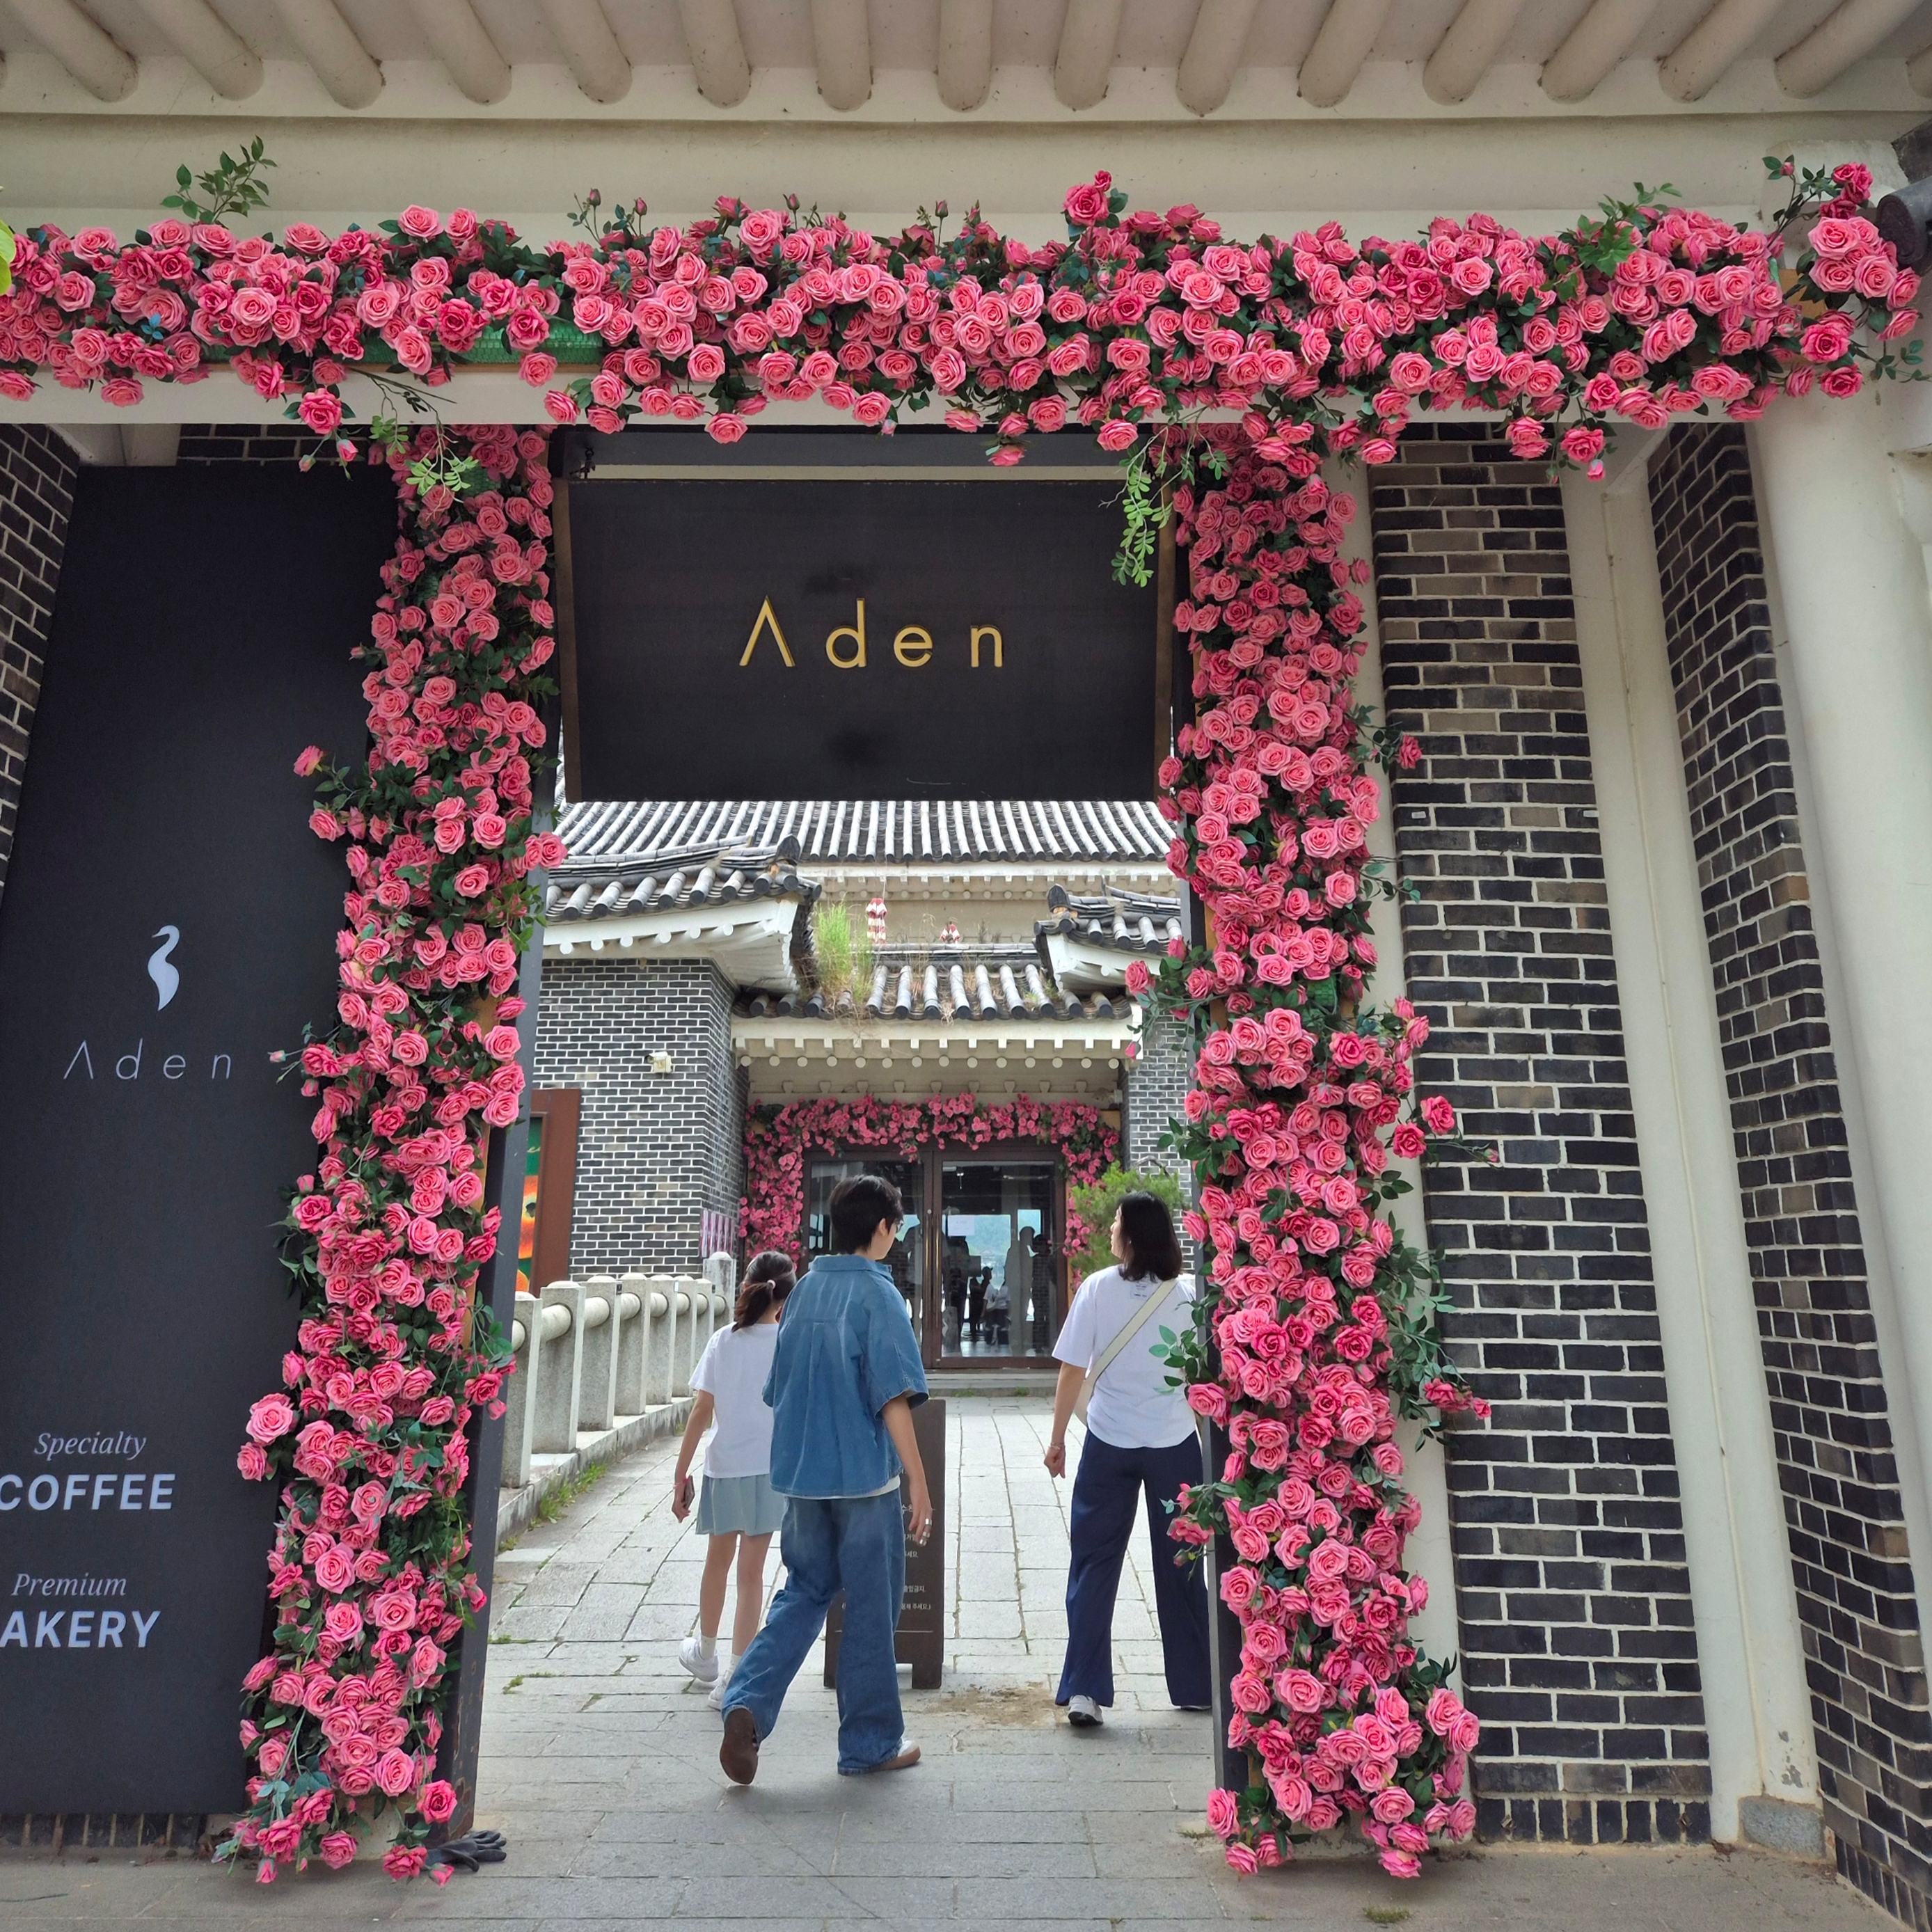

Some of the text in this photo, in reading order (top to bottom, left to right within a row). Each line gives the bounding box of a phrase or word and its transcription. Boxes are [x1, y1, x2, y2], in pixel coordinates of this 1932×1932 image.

[739, 595, 1004, 669] Aden
[63, 1038, 232, 1080] Aden
[34, 1431, 147, 1461] Specialty
[0, 1473, 176, 1511] COFFEE
[11, 1573, 127, 1597] Premium
